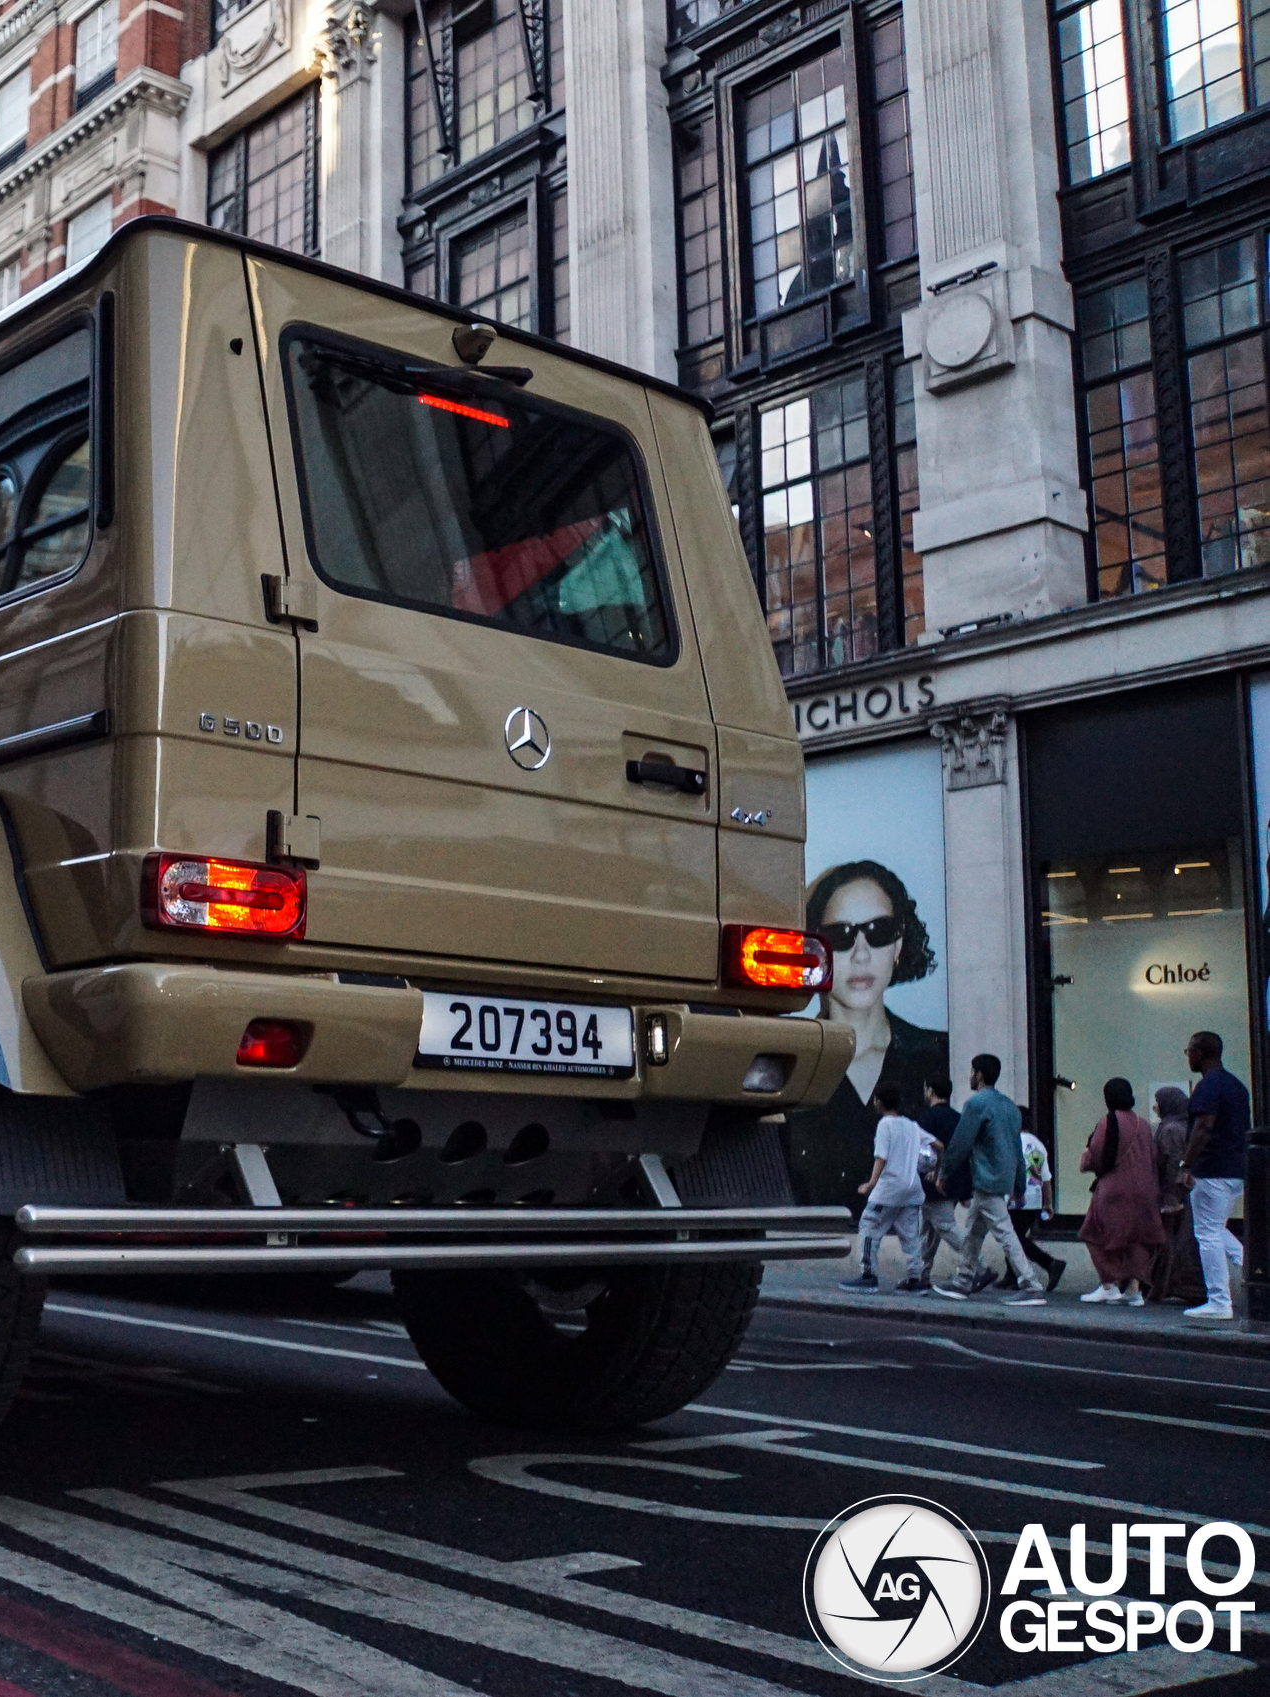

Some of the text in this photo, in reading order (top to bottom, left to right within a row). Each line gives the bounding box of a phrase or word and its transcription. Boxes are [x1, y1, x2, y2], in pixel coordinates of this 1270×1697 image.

[795, 674, 935, 731] ICHOLS
[200, 712, 283, 744] G 500
[1145, 961, 1211, 985] Chloé
[449, 1002, 603, 1060] 207394
[508, 1061, 532, 1071] NASSER
[543, 1063, 567, 1072] KHALED
[567, 1065, 607, 1075] AUTOMOBILES
